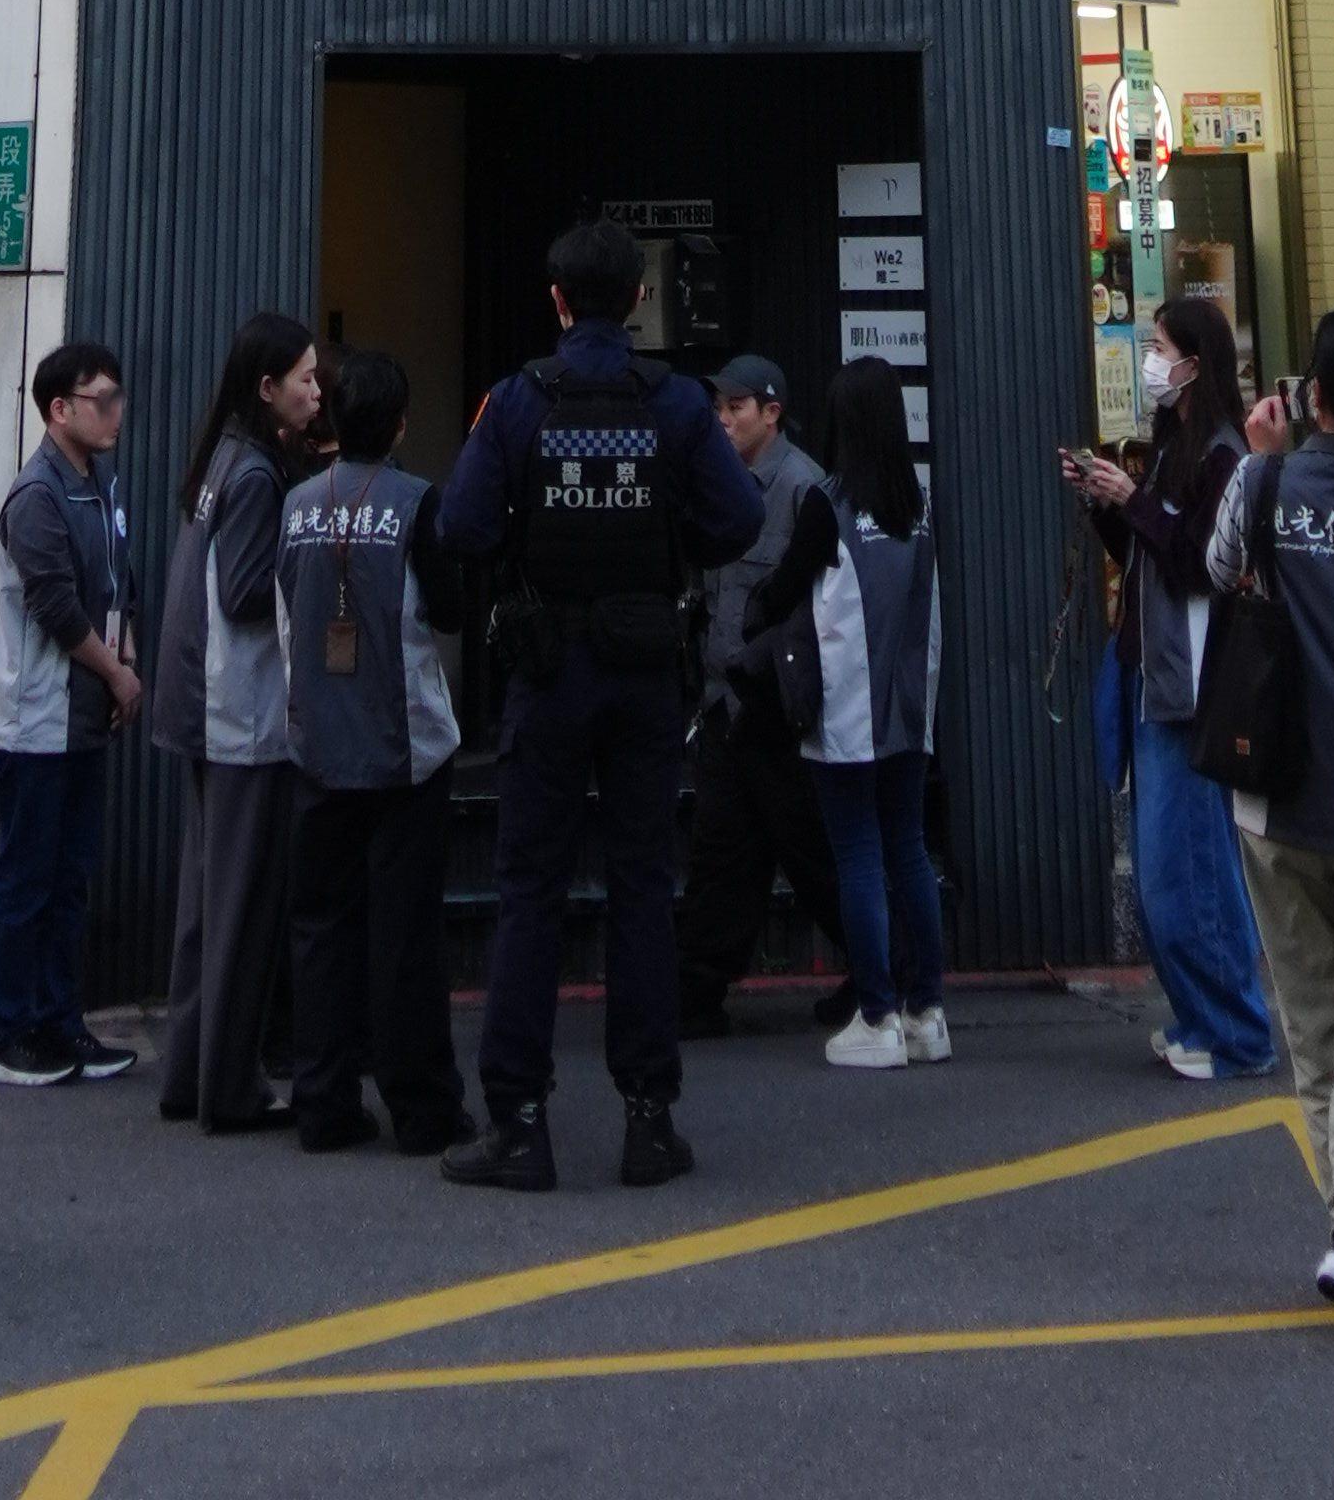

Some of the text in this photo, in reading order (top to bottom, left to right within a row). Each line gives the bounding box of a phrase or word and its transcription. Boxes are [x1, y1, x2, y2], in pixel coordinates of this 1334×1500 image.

[1136, 166, 1156, 259] 招募中
[874, 249, 903, 265] We2
[561, 461, 636, 485] 警察
[544, 486, 652, 509] POLICE
[287, 505, 401, 537] 觀光傳播局
